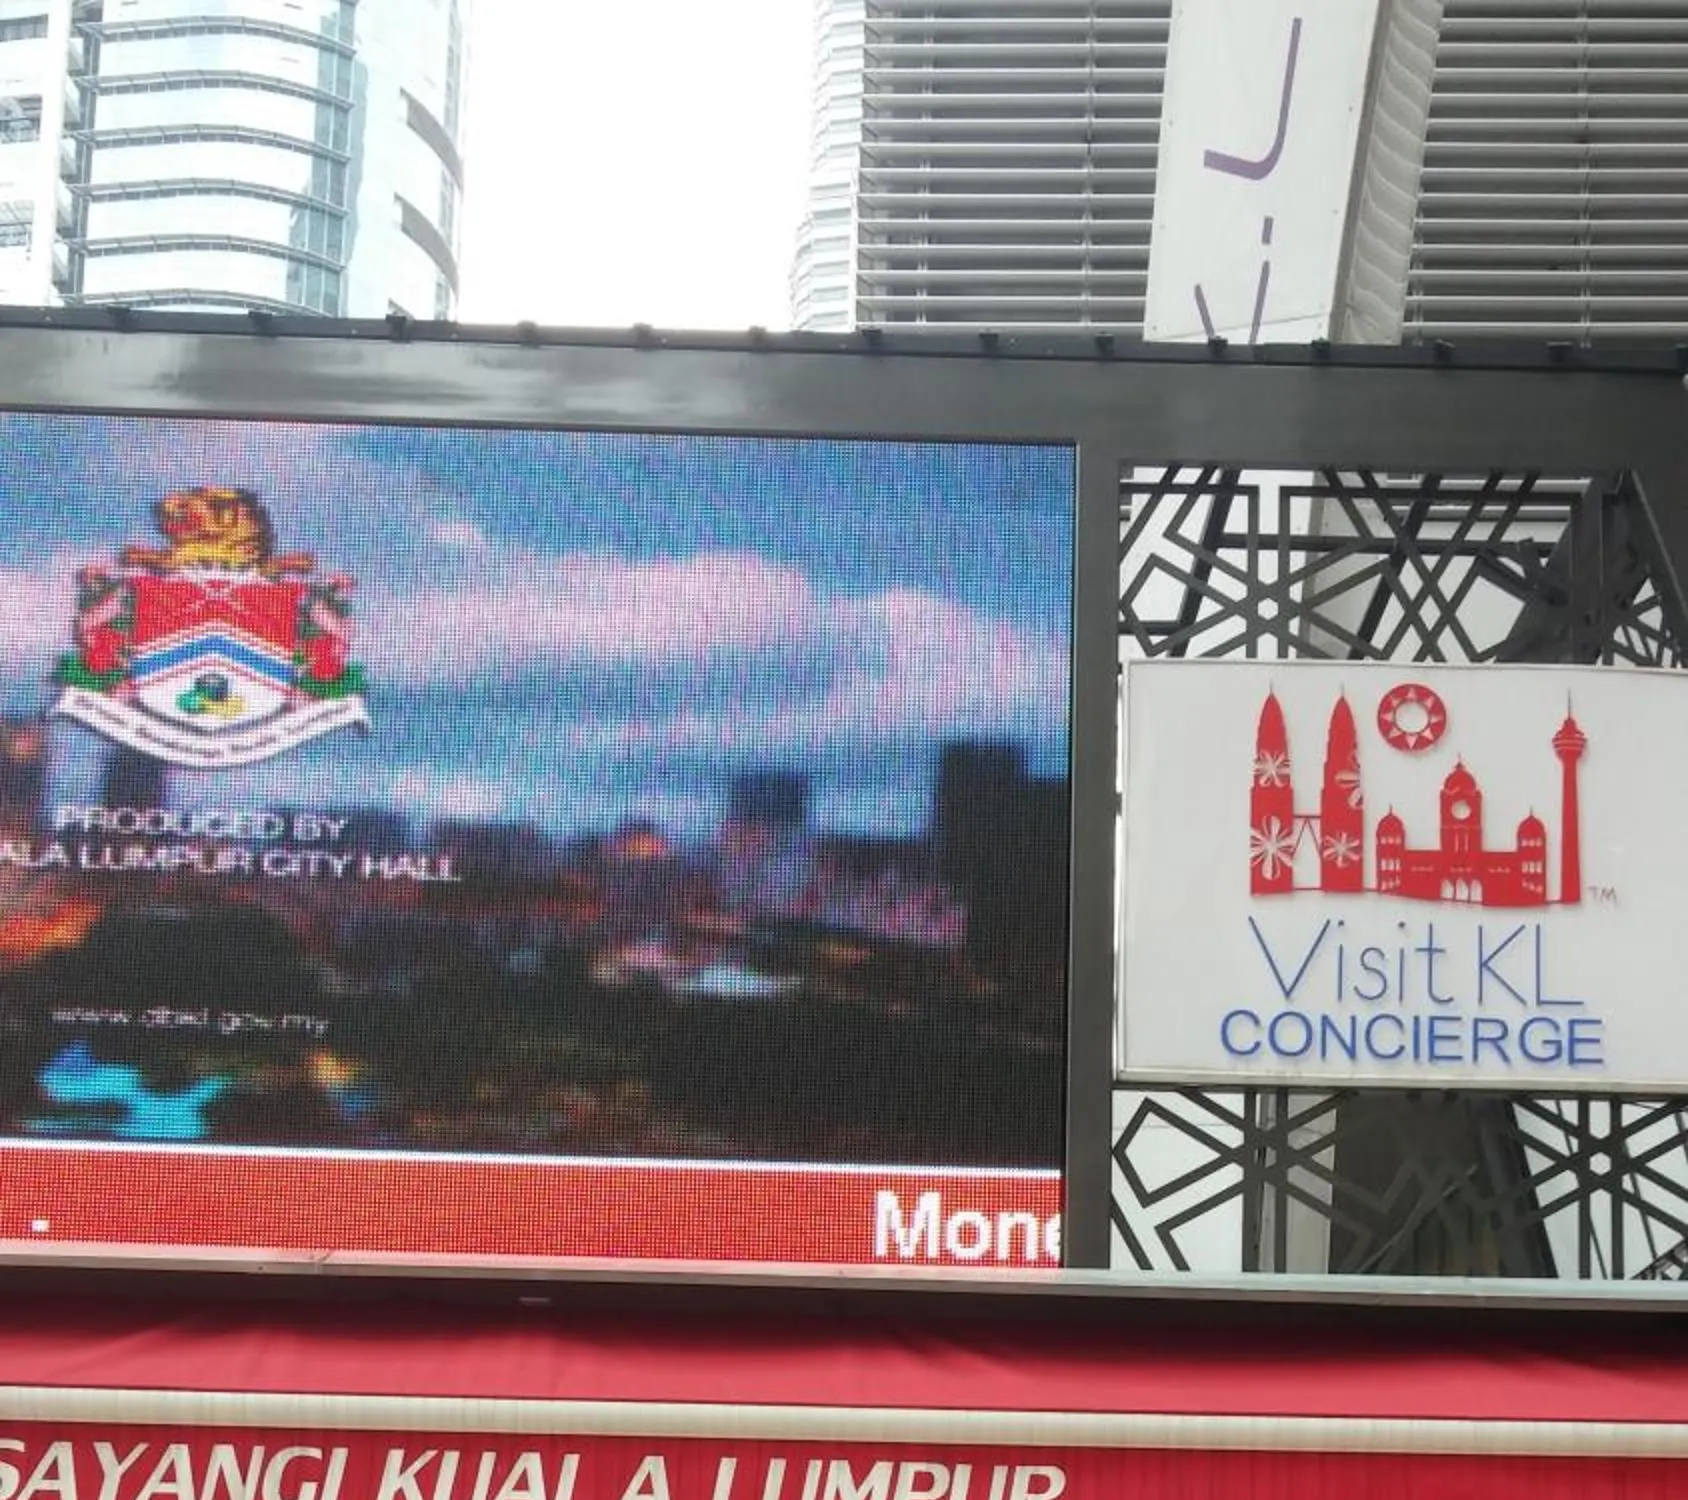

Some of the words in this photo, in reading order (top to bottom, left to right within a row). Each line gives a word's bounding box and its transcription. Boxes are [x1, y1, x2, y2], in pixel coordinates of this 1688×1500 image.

[54, 804, 285, 838] PRODUCED
[293, 812, 346, 841] BY
[80, 845, 254, 876] LUMPUR
[262, 850, 353, 878] CITY
[361, 854, 462, 882] HALL
[1247, 915, 1455, 1003] Visit
[1477, 923, 1585, 1007] KL
[1220, 1009, 1606, 1066] CONCIERGE
